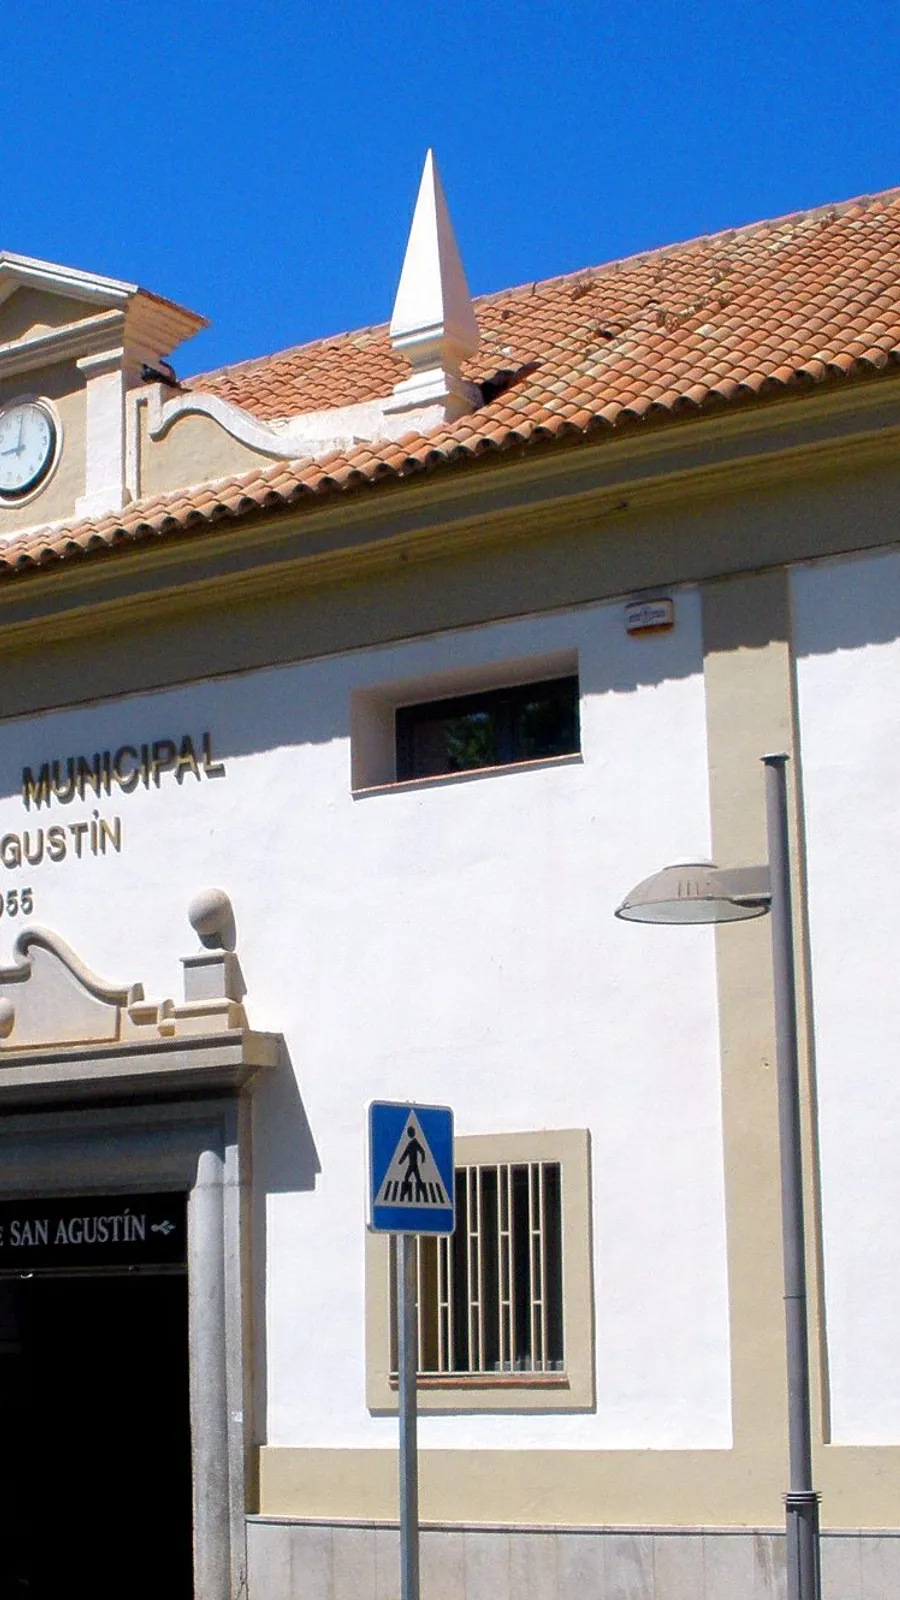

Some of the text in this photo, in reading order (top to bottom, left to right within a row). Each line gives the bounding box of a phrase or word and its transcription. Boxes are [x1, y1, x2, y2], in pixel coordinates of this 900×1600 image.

[22, 732, 221, 808] MUNICIPAL
[0, 887, 33, 917] 55
[10, 1219, 48, 1246] SAN
[54, 1208, 146, 1244] AGUSTÍN
